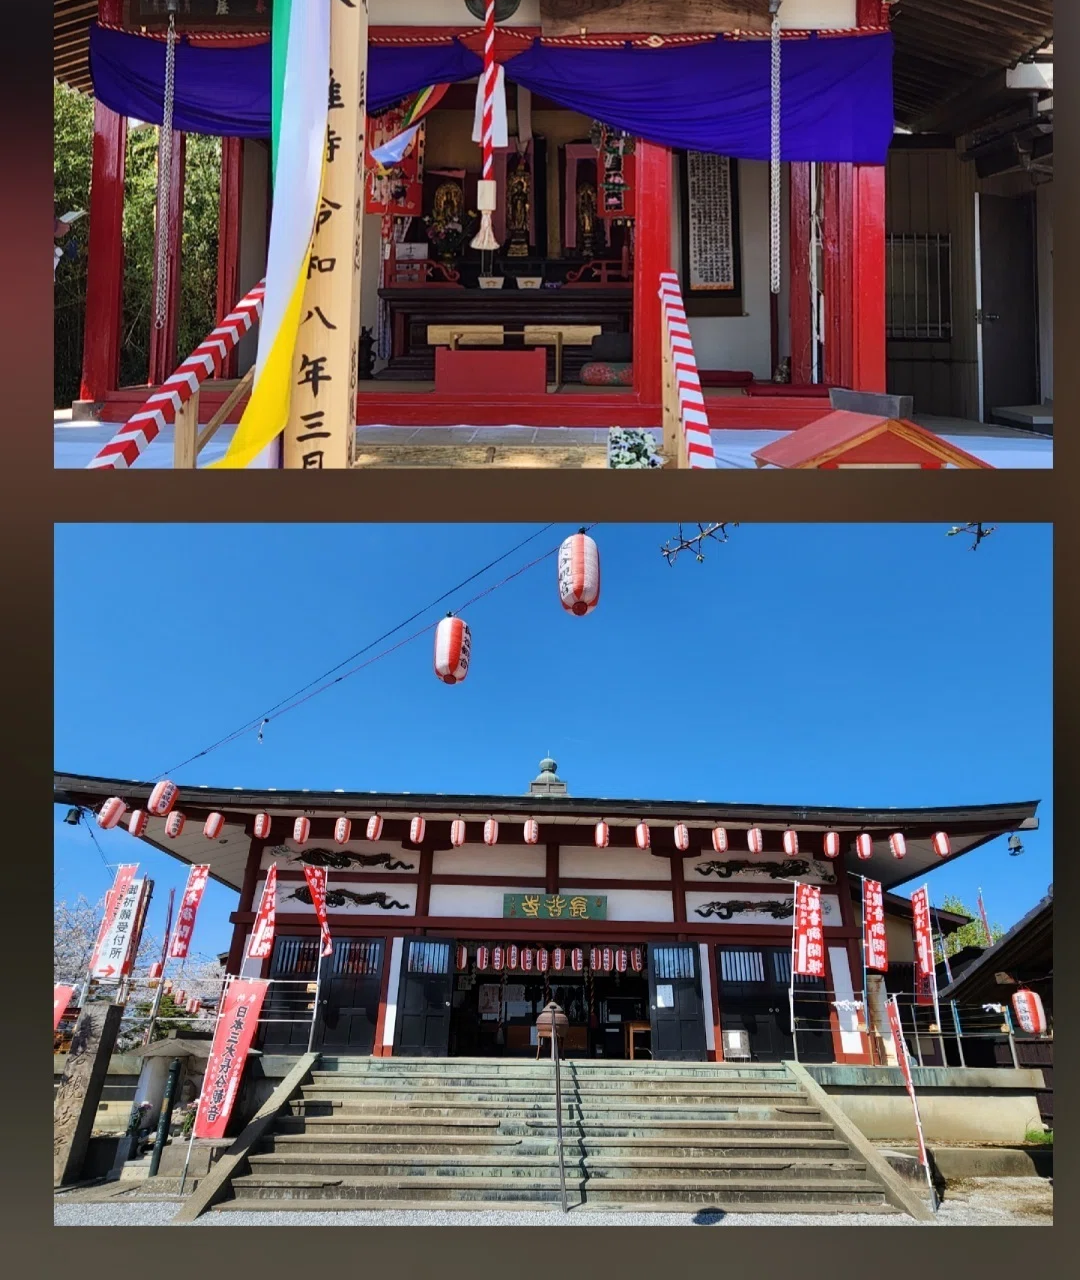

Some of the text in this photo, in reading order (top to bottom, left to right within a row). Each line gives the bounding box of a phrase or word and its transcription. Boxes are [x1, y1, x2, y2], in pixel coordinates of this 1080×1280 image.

[106, 883, 139, 960] 御祈願受付所
